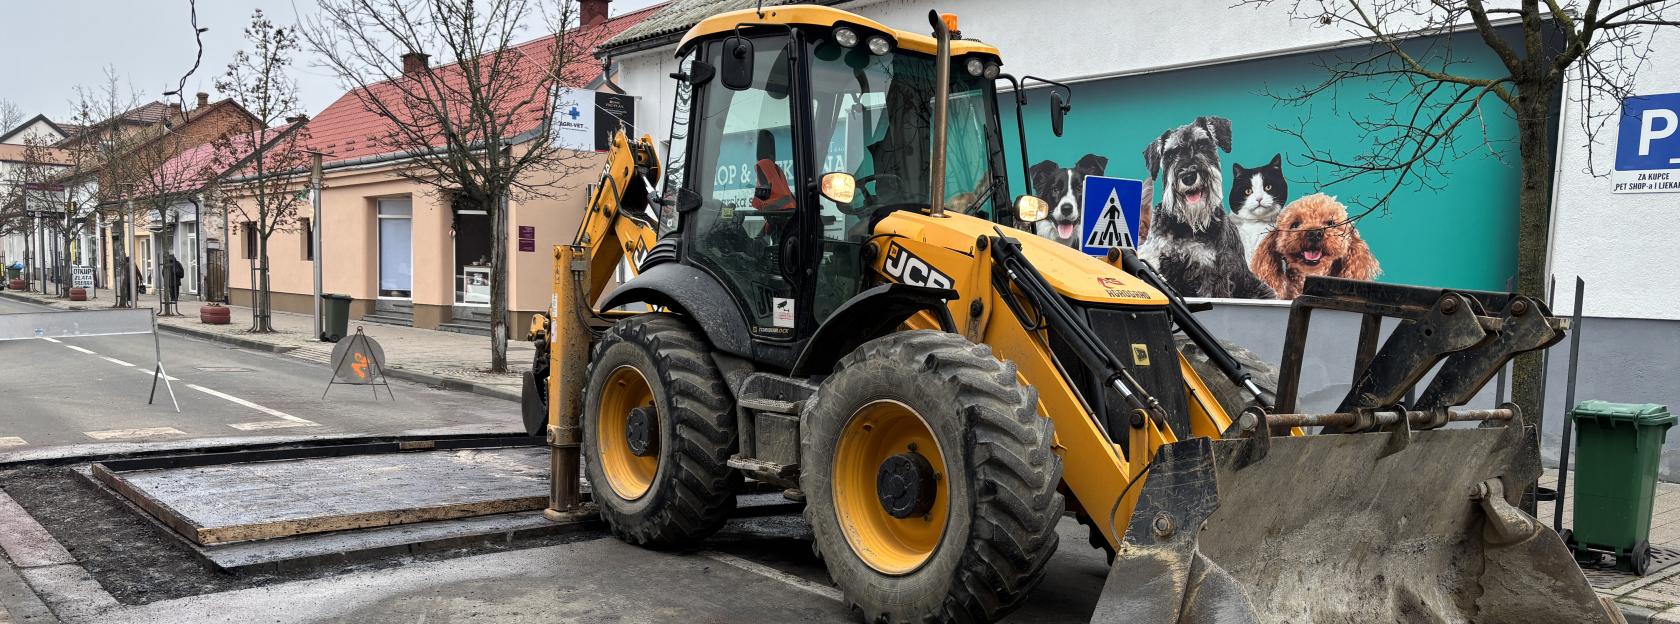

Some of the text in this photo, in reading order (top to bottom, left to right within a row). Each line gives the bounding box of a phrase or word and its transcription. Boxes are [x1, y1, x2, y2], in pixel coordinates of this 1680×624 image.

[1638, 109, 1679, 156] P
[740, 163, 751, 183] &
[1648, 172, 1670, 180] KUPCE
[1628, 182, 1653, 190] SHOP-a
